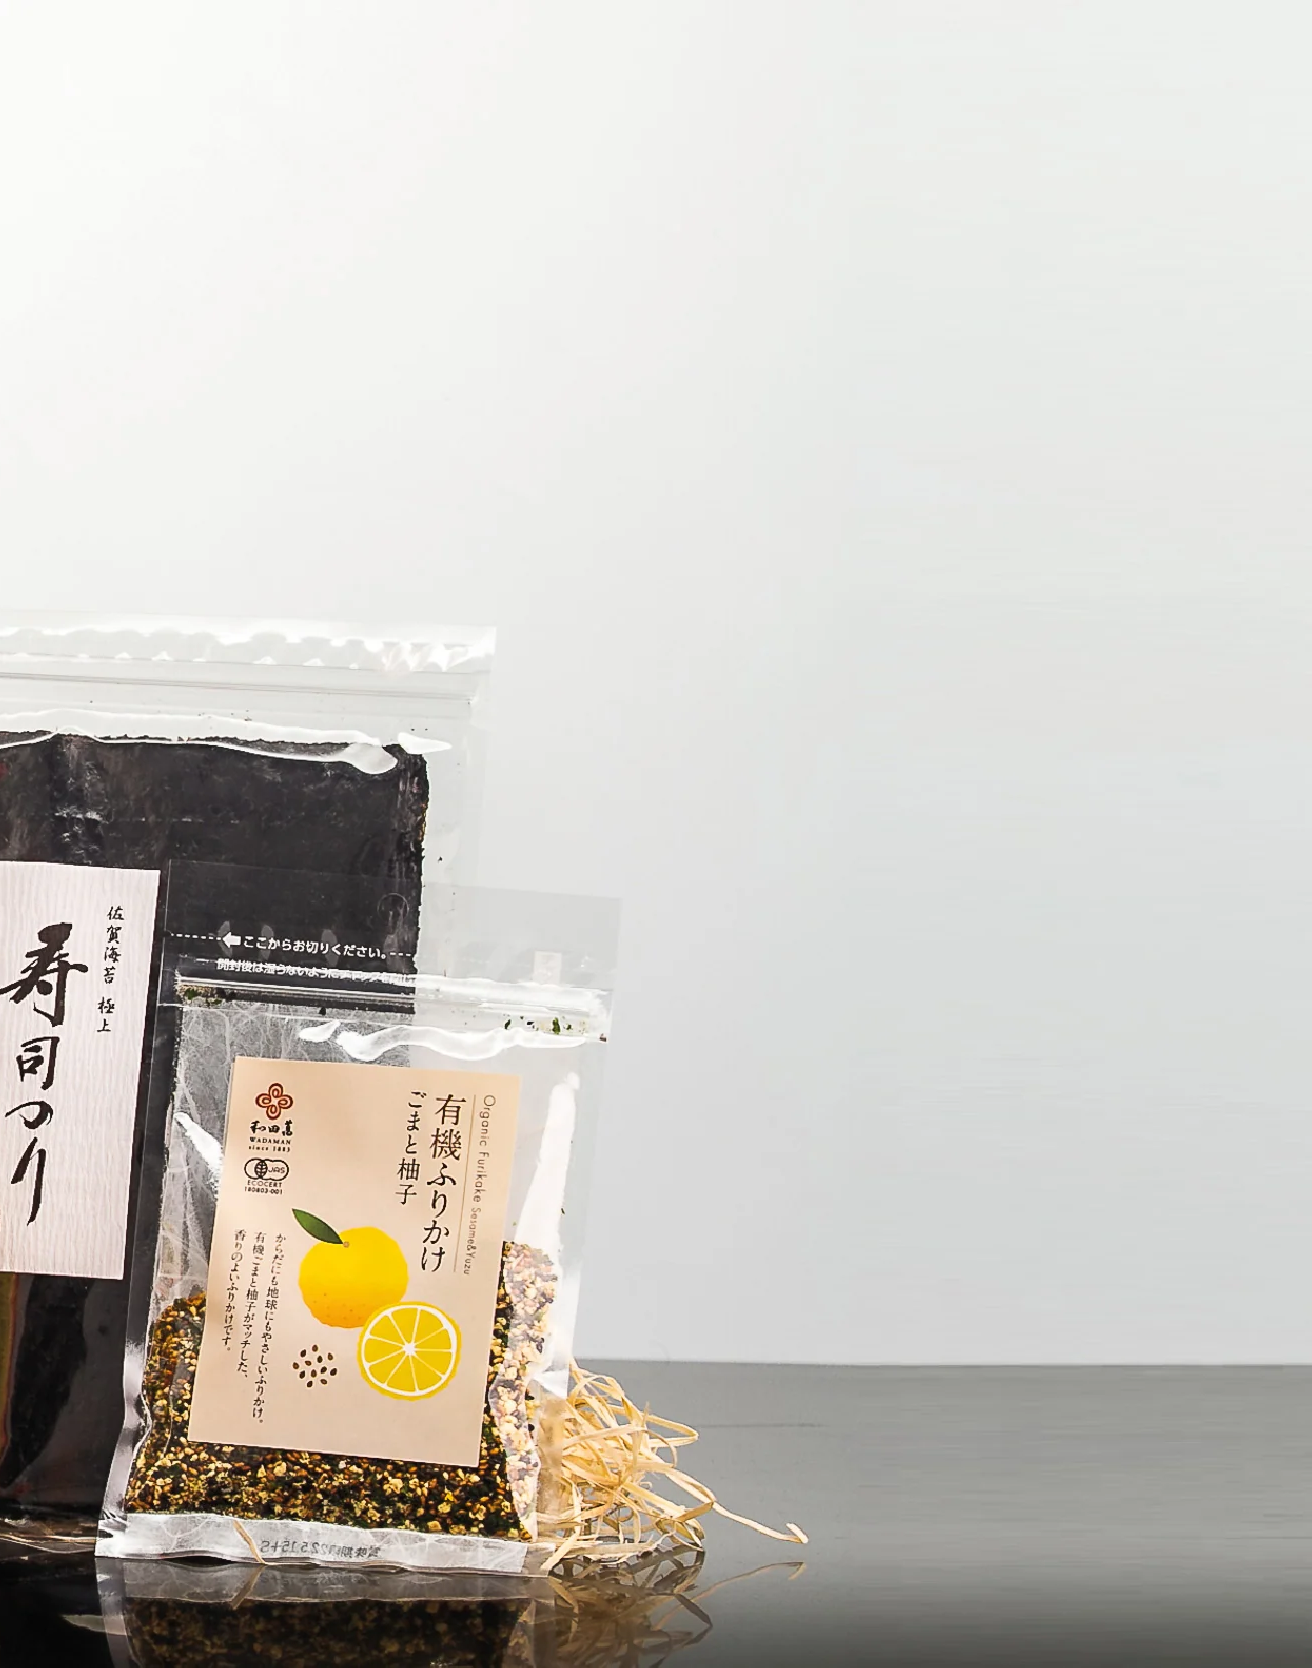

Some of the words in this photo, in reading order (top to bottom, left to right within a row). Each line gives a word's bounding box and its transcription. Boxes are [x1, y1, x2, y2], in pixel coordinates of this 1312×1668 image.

[243, 937, 387, 959] ここからお切りください。
[97, 996, 116, 1033] 極上
[249, 1137, 291, 1145] WADAMAN
[479, 1095, 496, 1146] Organic
[395, 1091, 427, 1205] ごまと柚子
[247, 1180, 282, 1188] ECOCERT
[421, 1094, 466, 1272] 有機ふりかけ
[473, 1151, 490, 1203] Furikake
[222, 1229, 248, 1351] 香りのよいふりかけです。
[237, 1231, 267, 1378] 有機ごまと柚子がマッチした、
[252, 1233, 287, 1424] からだにも地球にもやさしいふりかけ。
